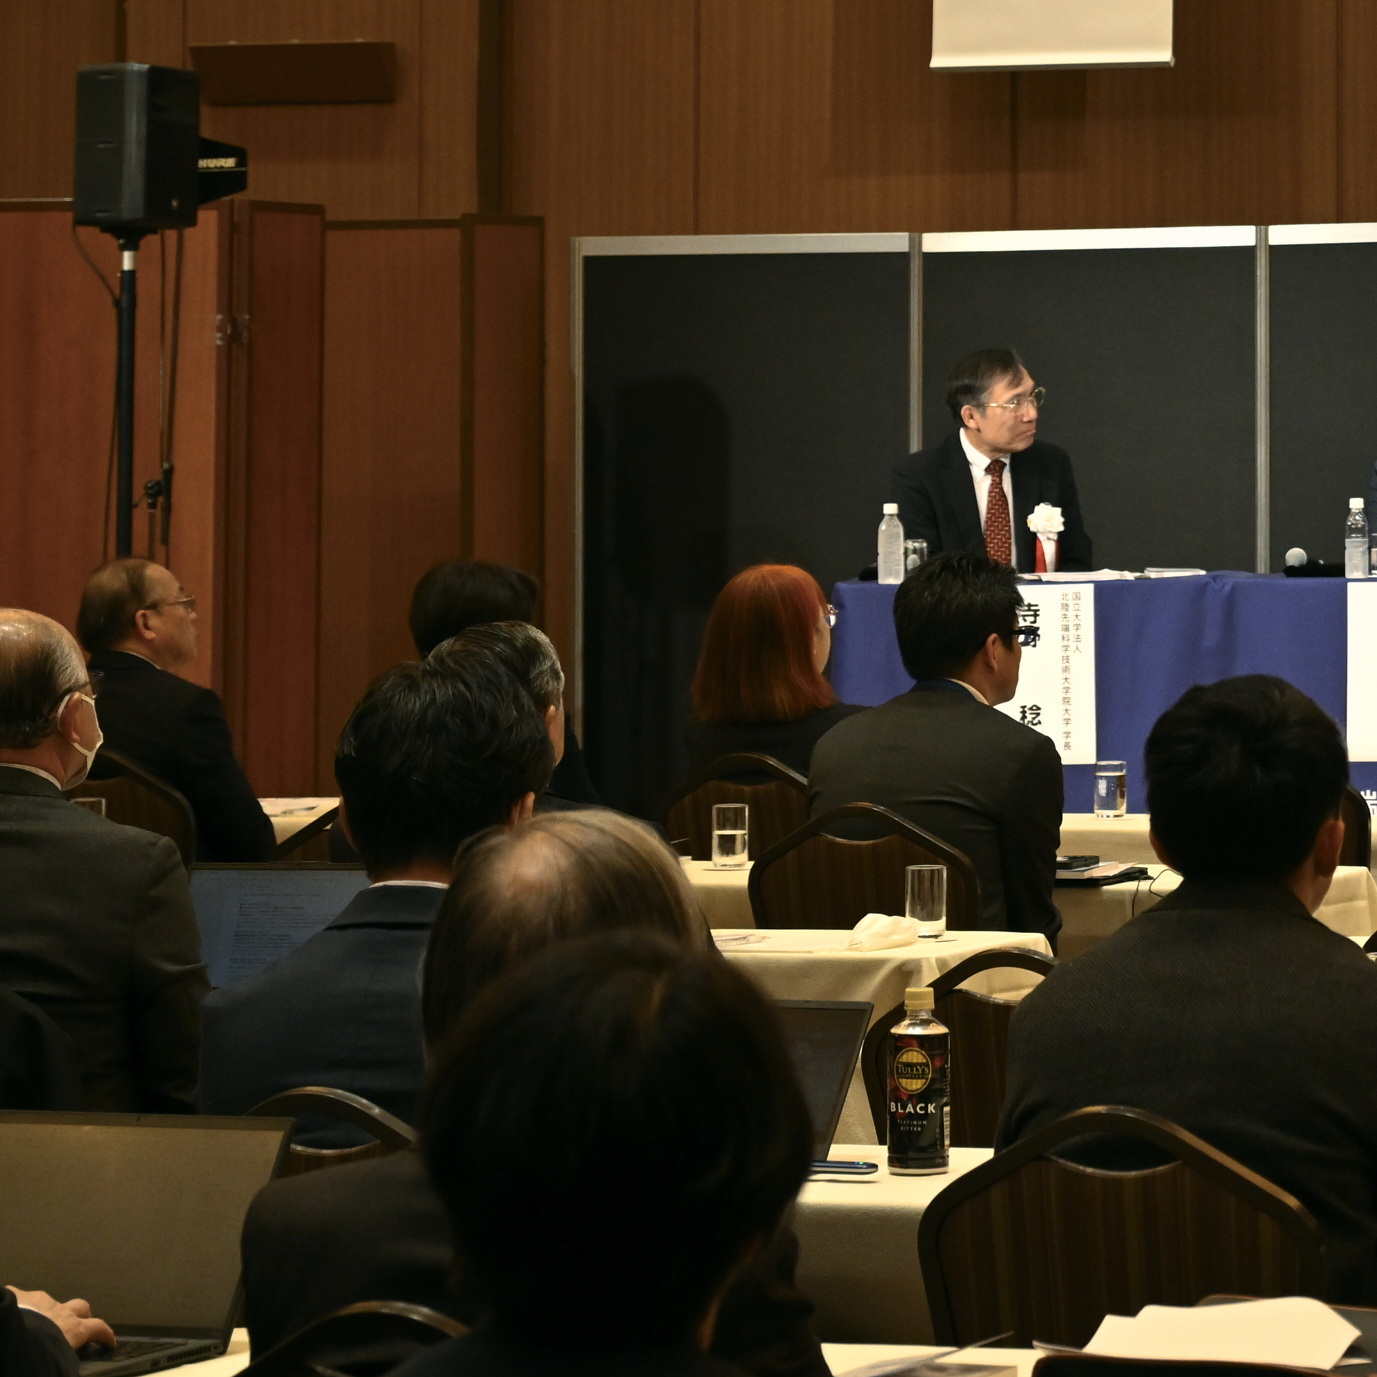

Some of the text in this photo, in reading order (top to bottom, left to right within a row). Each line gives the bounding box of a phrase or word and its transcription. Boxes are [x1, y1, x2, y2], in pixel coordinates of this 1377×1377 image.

[1072, 591, 1082, 654] 国立大学法人
[890, 1102, 936, 1114] BLACK
